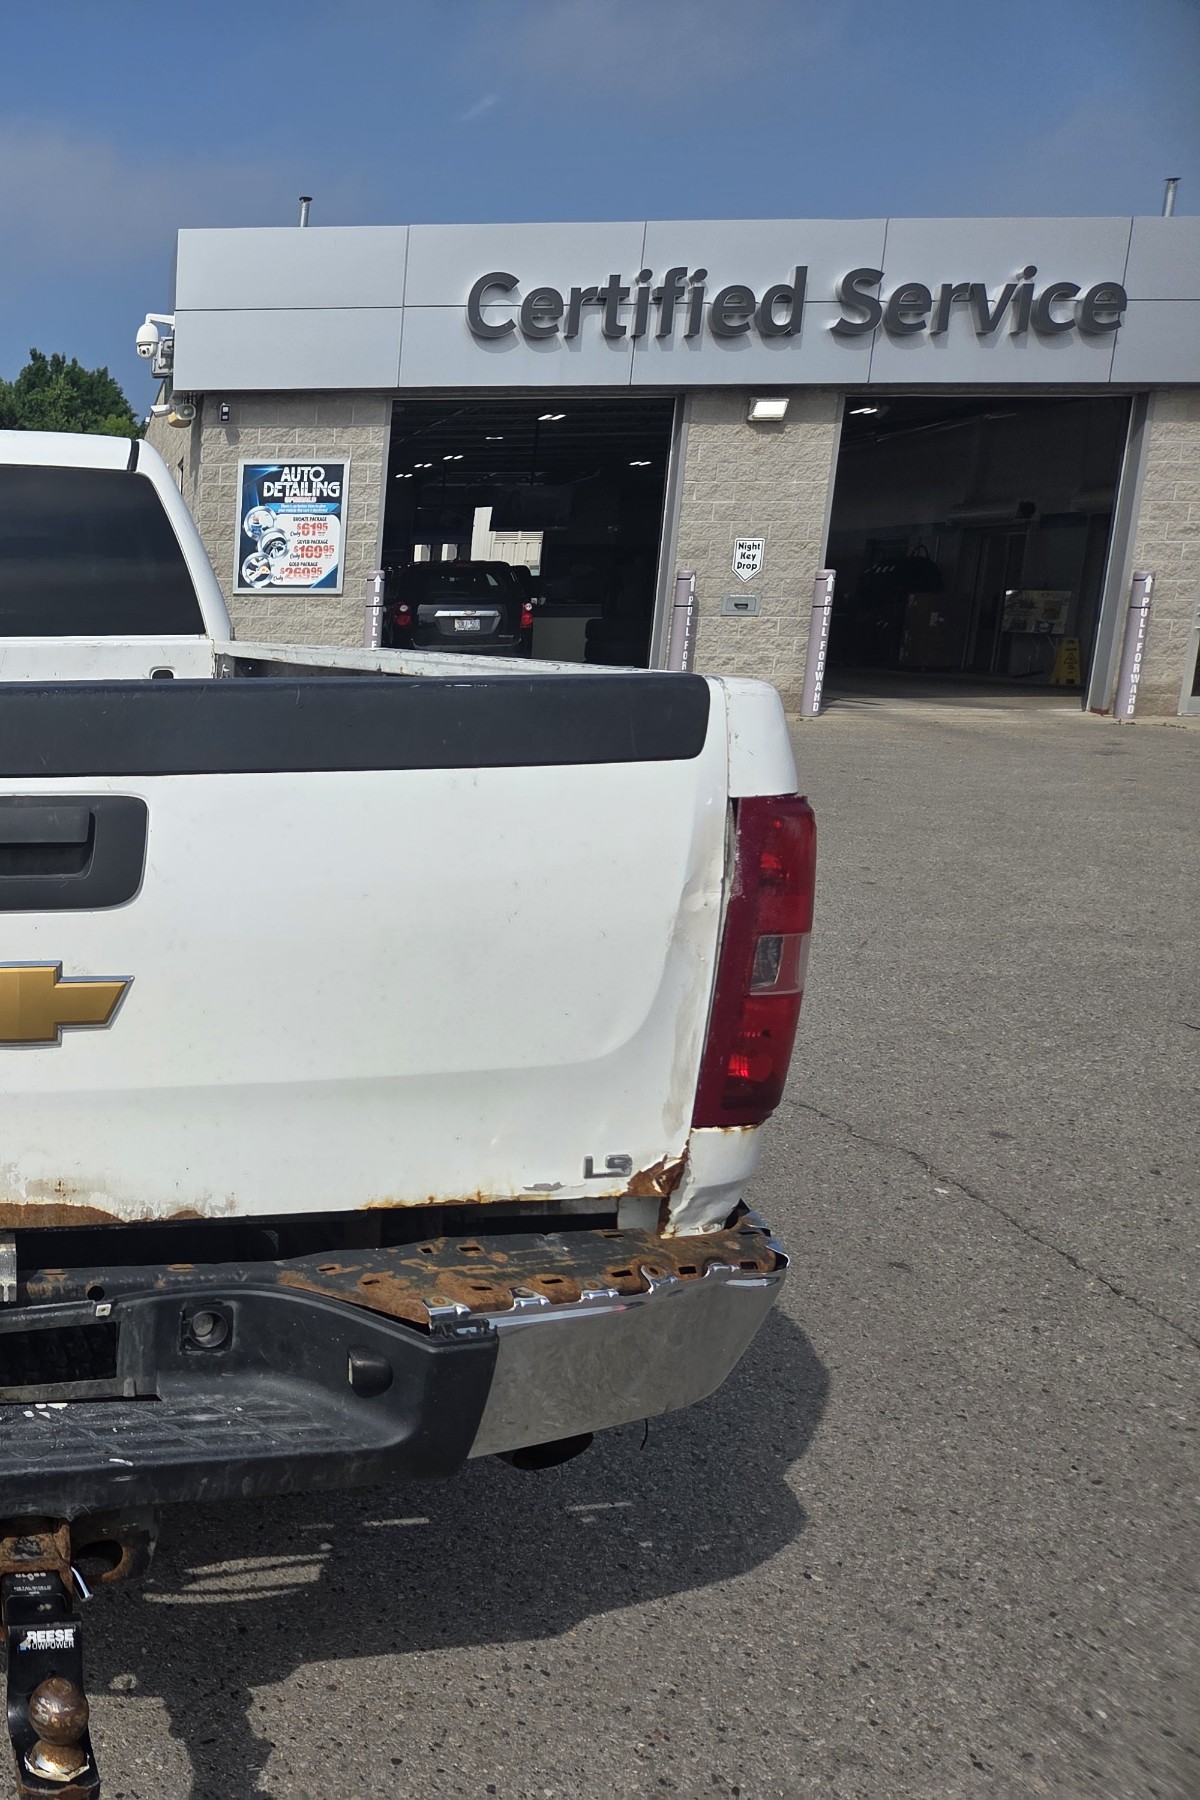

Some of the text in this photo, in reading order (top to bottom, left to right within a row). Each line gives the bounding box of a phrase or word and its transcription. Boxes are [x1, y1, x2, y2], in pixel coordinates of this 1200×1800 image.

[467, 264, 1128, 339] Certified Service
[280, 466, 325, 482] AUTO
[263, 481, 341, 497] DETAILING
[738, 542, 760, 551] Night
[740, 552, 757, 561] Key
[737, 562, 758, 571] Drop
[372, 596, 380, 637] PULL
[685, 595, 694, 637] PULL
[812, 595, 831, 712] PULL FORWARD
[1126, 597, 1150, 715] PULL FORWARD
[26, 1628, 74, 1643] REESE
